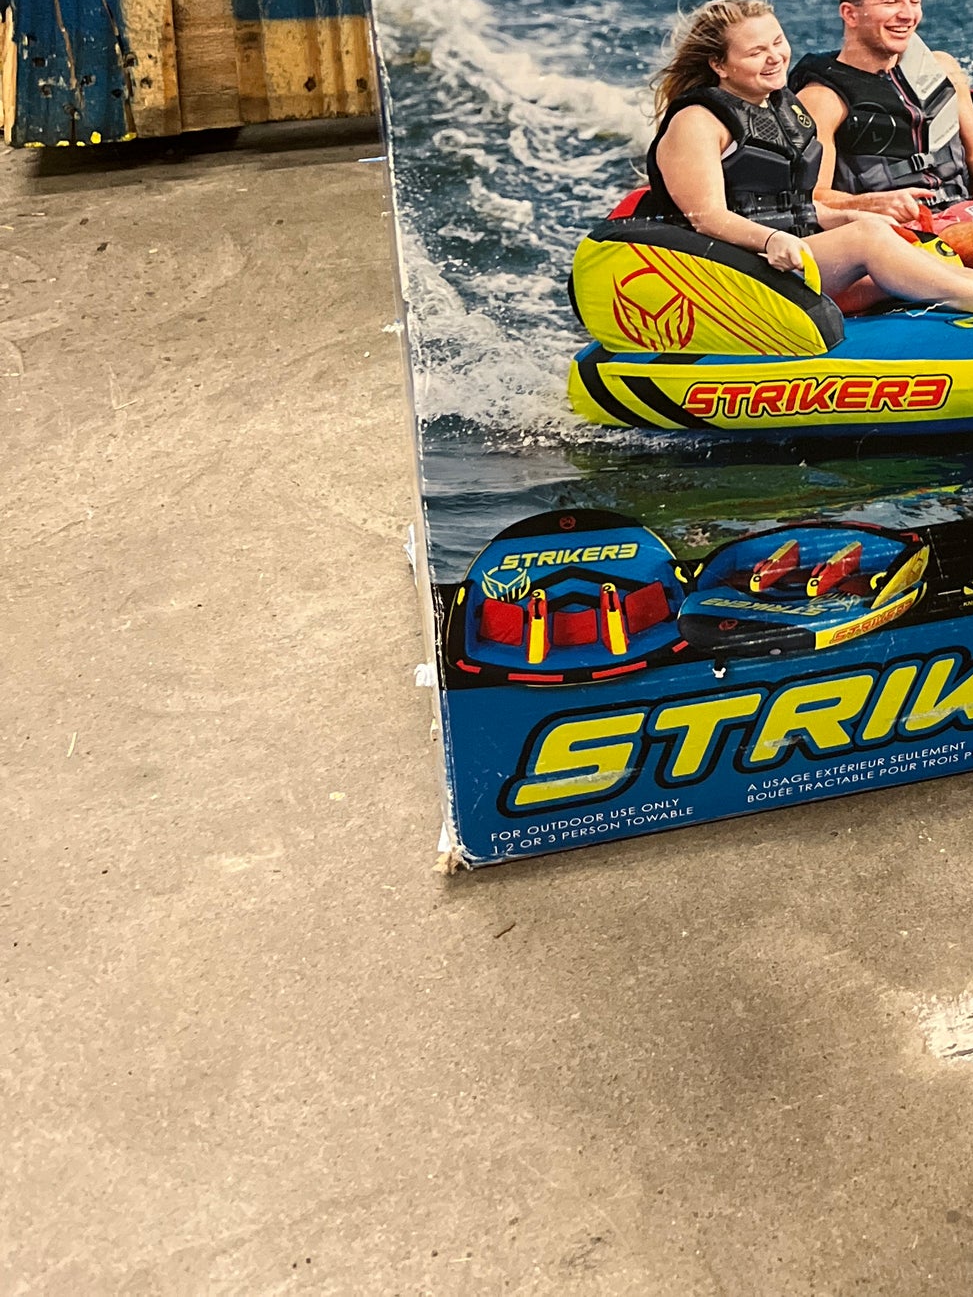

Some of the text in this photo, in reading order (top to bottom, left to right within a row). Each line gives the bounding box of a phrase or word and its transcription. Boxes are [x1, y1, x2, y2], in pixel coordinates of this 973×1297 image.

[684, 377, 949, 416] STRIKER3
[500, 543, 639, 570] STRIKER3
[747, 741, 967, 792] A USAGE EXTÉRIEUR SEULEMENT
[747, 785, 794, 803] BOUÉE
[798, 769, 875, 792] TRACTABLE
[879, 762, 918, 777] POUR
[922, 754, 960, 769] TROIS
[490, 798, 680, 842] FOR OUTDOOR USE ONLY
[520, 837, 542, 849] OR
[548, 834, 556, 843] 3
[561, 821, 621, 840] PERSON
[626, 806, 695, 827] TOWABLE
